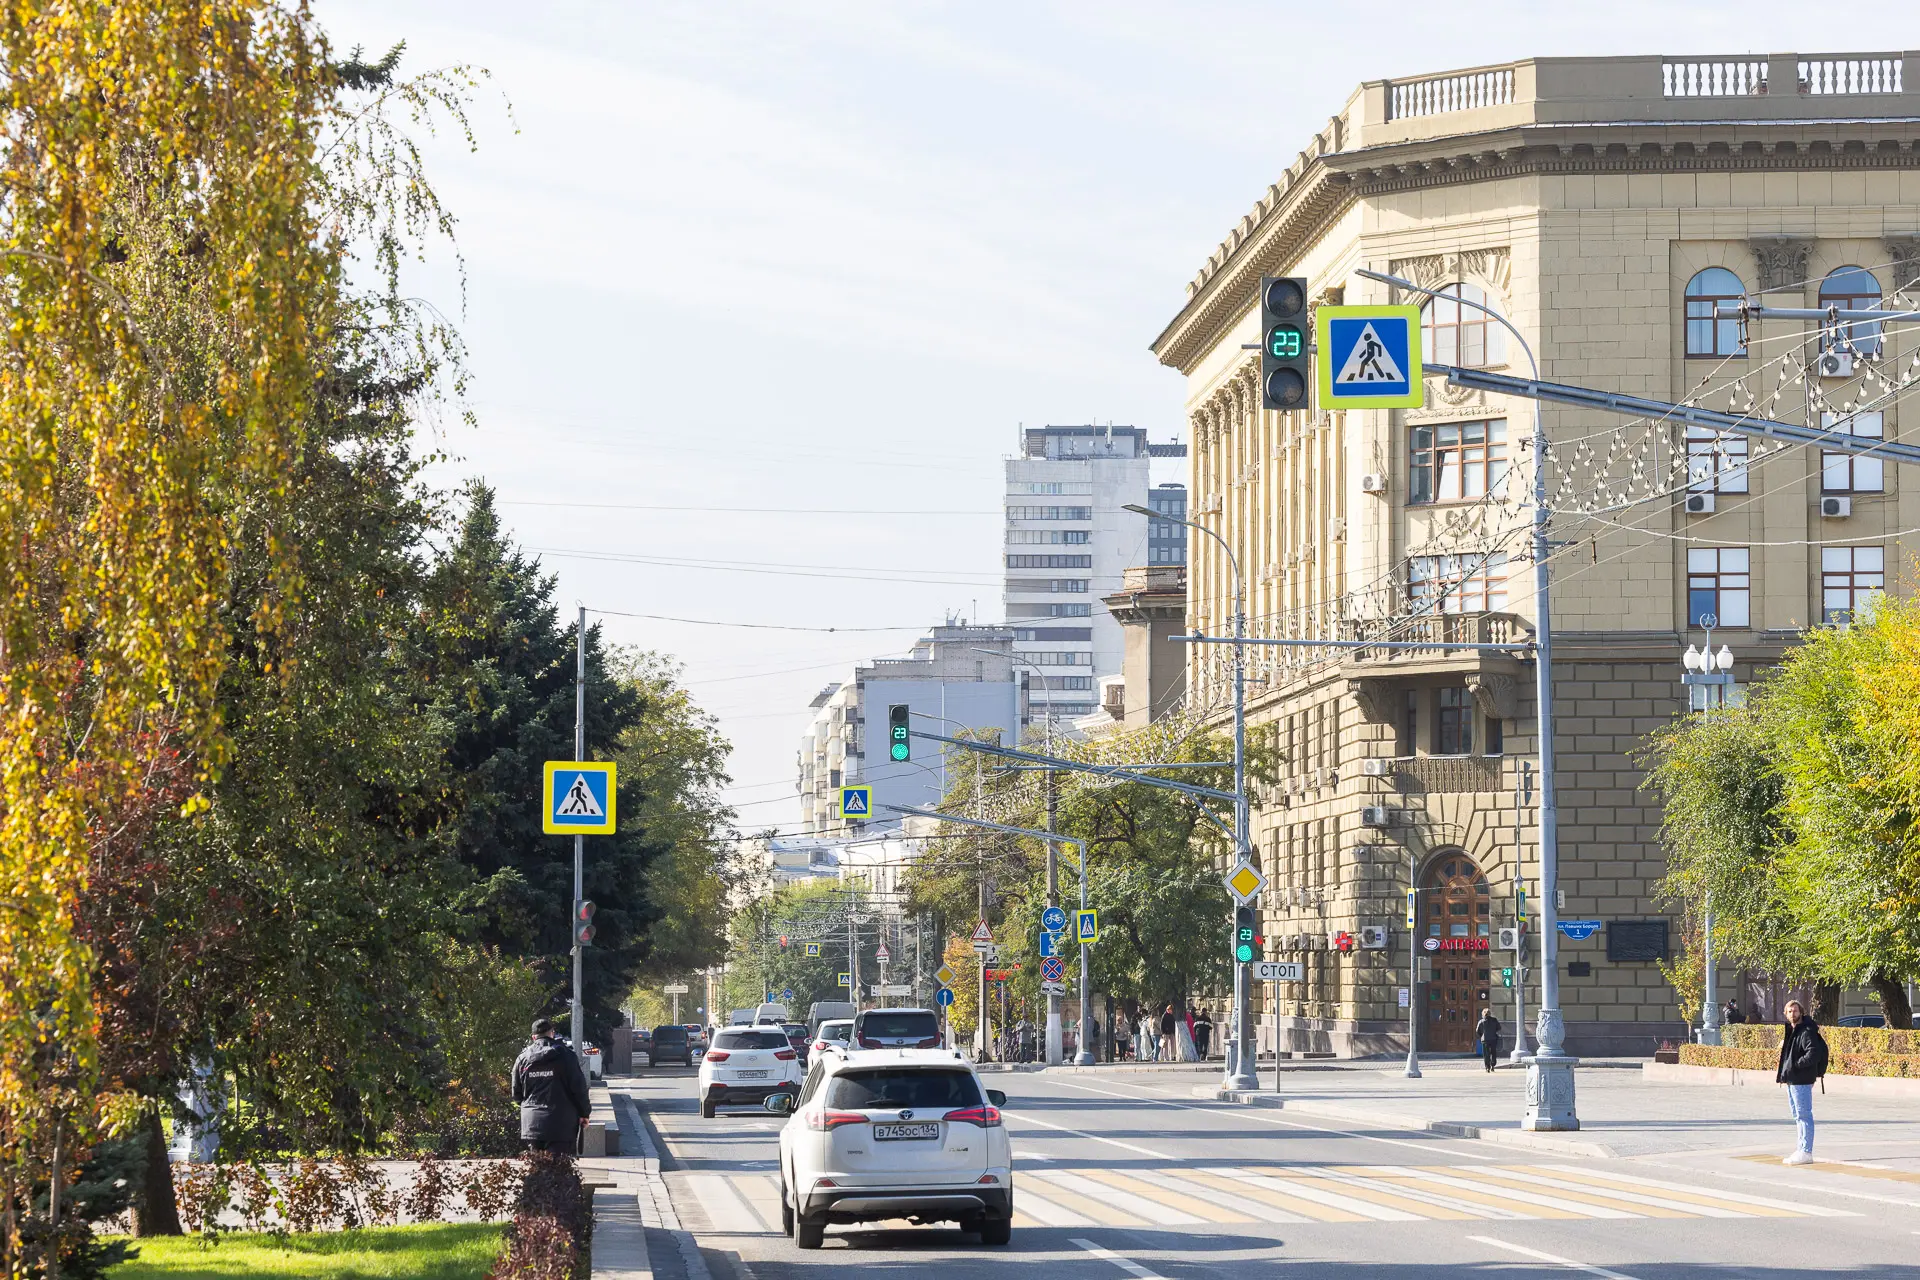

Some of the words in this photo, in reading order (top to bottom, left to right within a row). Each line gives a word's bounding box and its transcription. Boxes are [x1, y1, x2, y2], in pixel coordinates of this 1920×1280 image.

[1273, 331, 1300, 356] 23
[894, 727, 907, 739] 23
[1240, 929, 1252, 940] 23
[1440, 938, 1489, 950] АПТЕКА
[1260, 964, 1296, 978] СТОП
[528, 1070, 554, 1078] ПОЛИЦИЯ
[920, 1124, 936, 1133] 134
